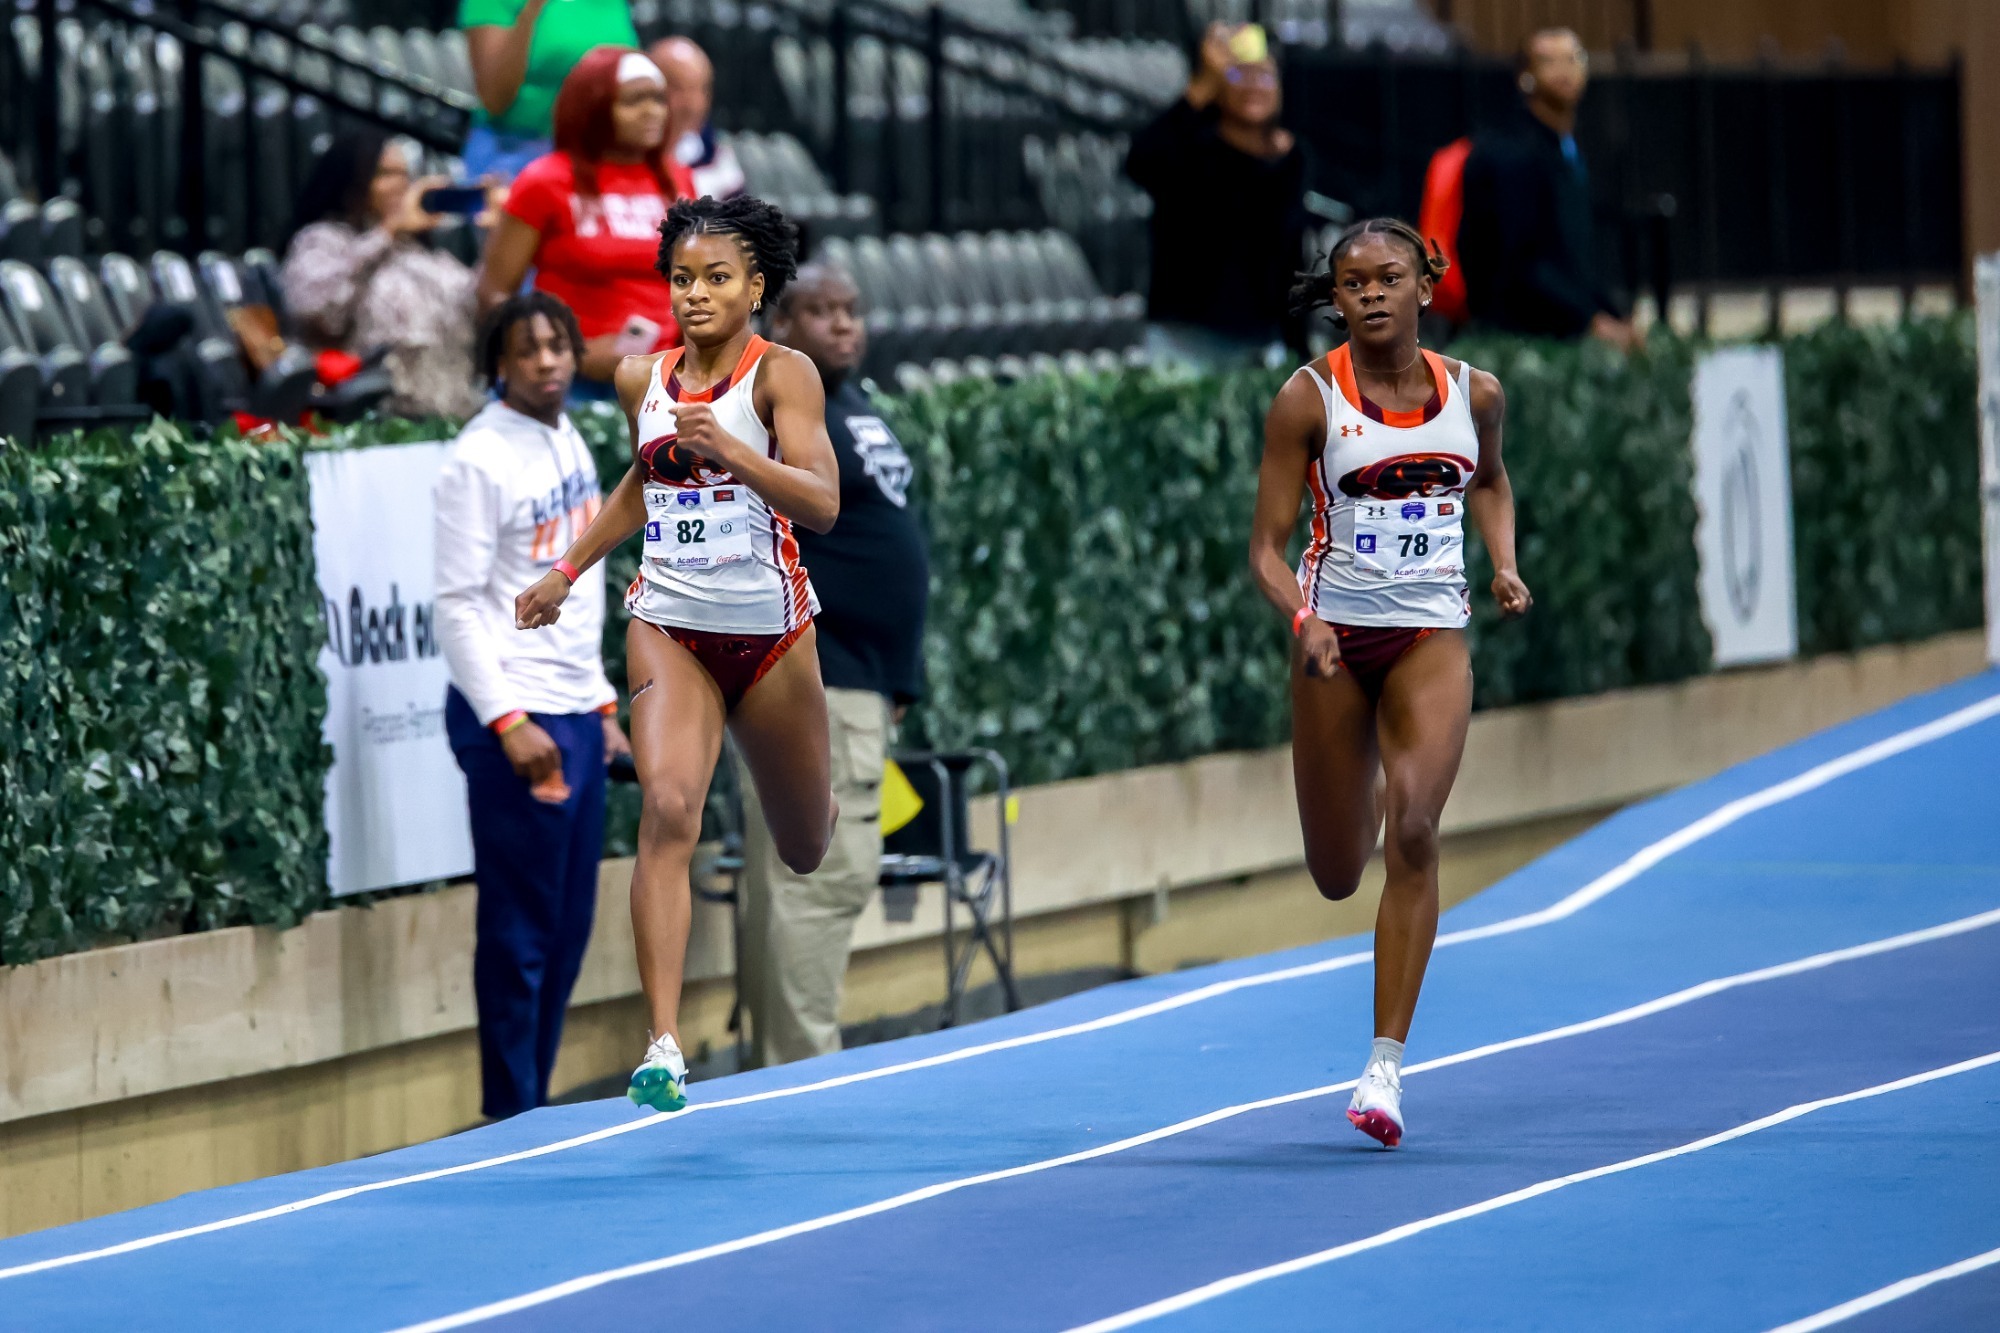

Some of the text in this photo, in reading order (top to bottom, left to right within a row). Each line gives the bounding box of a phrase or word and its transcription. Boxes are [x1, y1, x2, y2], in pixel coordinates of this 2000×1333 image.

[677, 519, 706, 544] 82
[1397, 533, 1429, 557] 78
[677, 557, 710, 566] Academy
[1394, 568, 1430, 577] Academy
